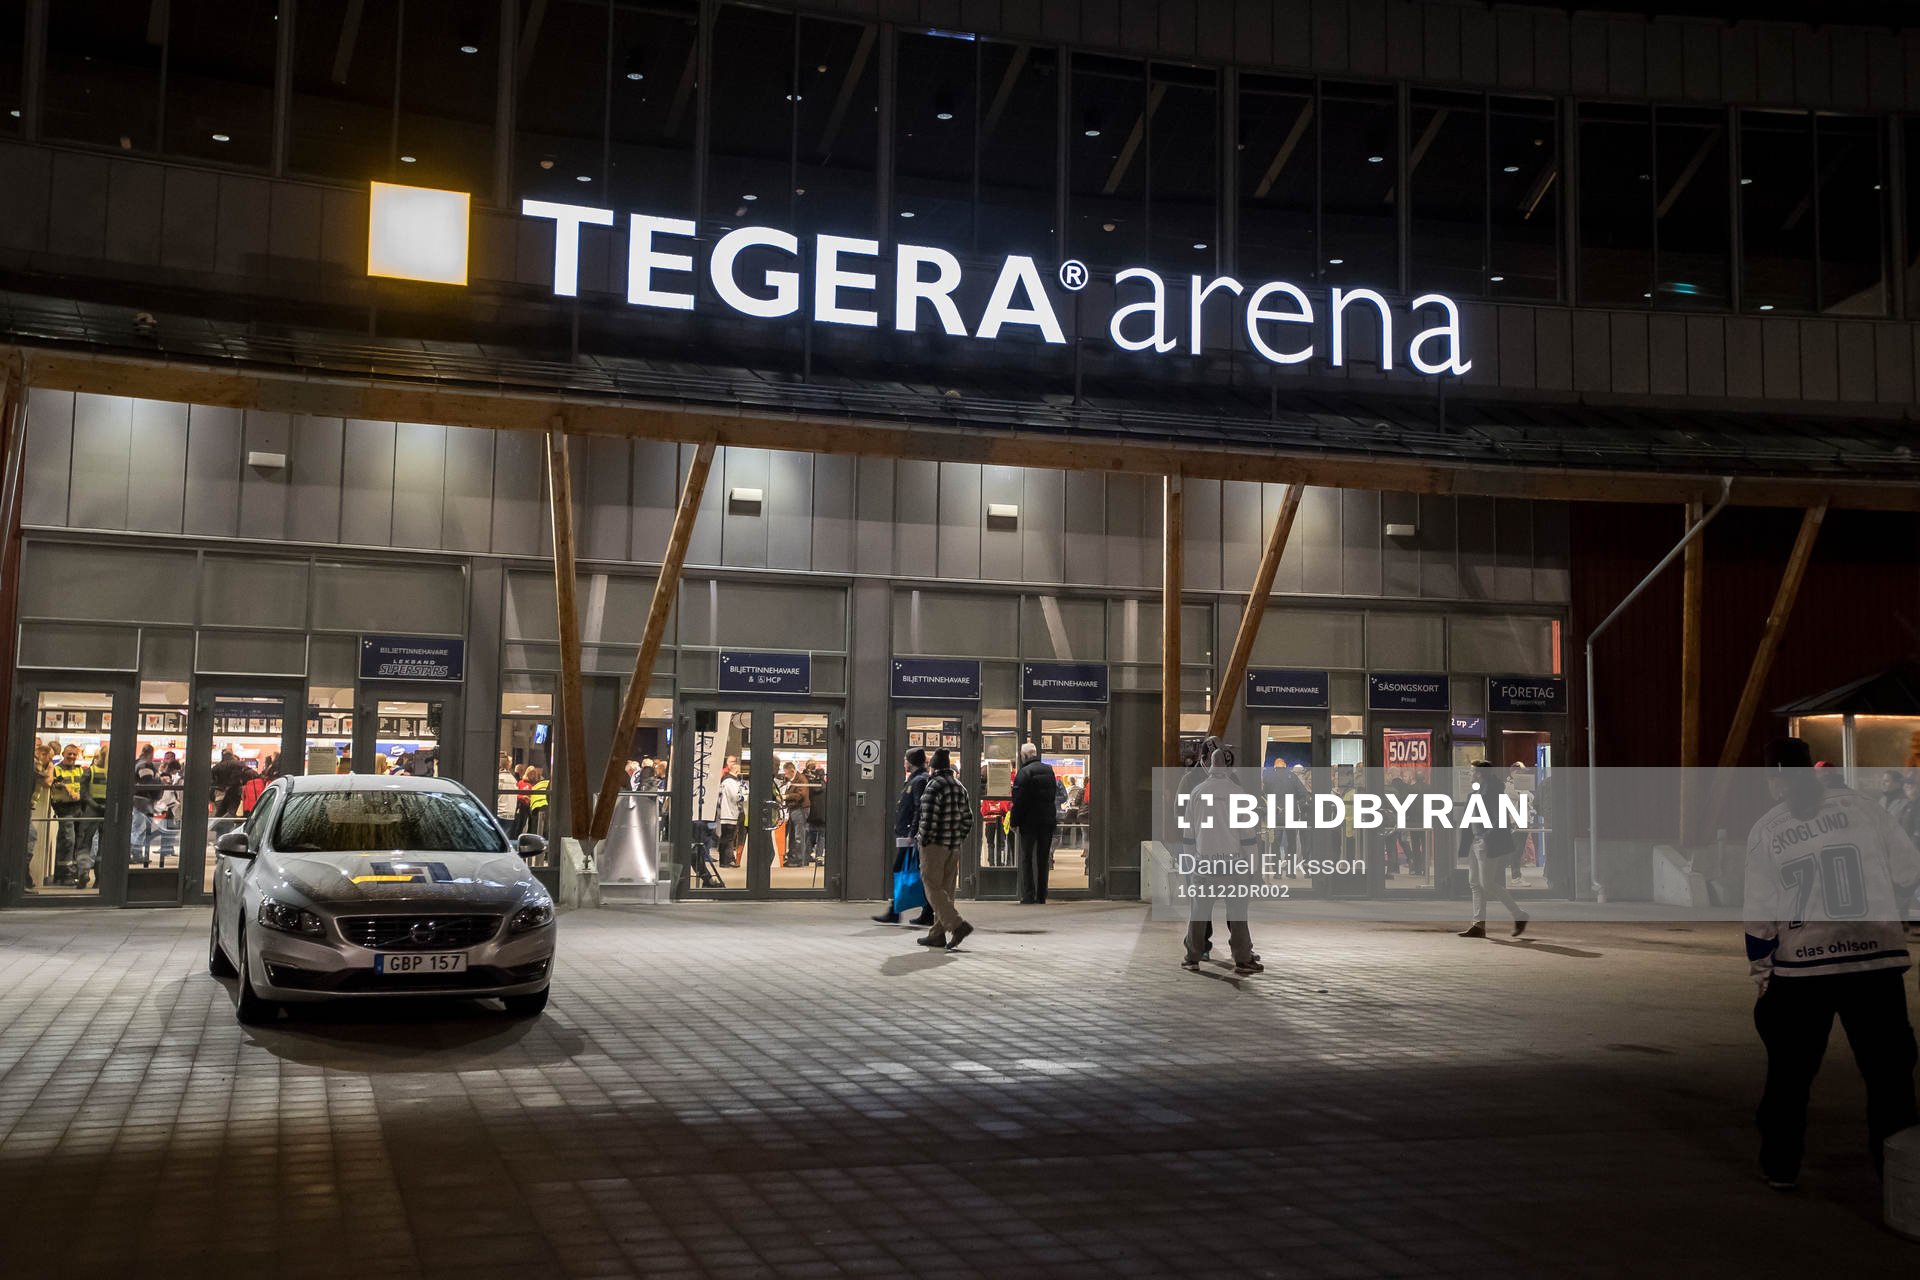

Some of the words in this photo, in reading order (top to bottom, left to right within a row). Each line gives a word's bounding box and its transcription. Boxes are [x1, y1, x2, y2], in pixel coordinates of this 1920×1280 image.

[1110, 266, 1472, 375] arena
[378, 664, 449, 677] SUPERSTARS
[729, 665, 800, 675] BILJETTINNEHAVARE
[766, 676, 782, 684] HCP
[902, 675, 970, 684] BILJETTINNEHAVARE
[1032, 679, 1099, 688] BILJETTINNEHAVARE
[1255, 685, 1320, 694] BILJETTINNEHAVARE
[1378, 681, 1440, 693] SÄSONGSKORT
[1501, 684, 1555, 699] FÖRETAG
[863, 745, 872, 759] 4
[1389, 740, 1427, 762] 50/50
[1771, 812, 1849, 855] SKOGLUND
[1779, 843, 1868, 930] 70
[1796, 944, 1824, 958] clas
[1828, 939, 1879, 954] ohlson
[390, 956, 423, 971] GBP
[430, 955, 461, 970] 157
